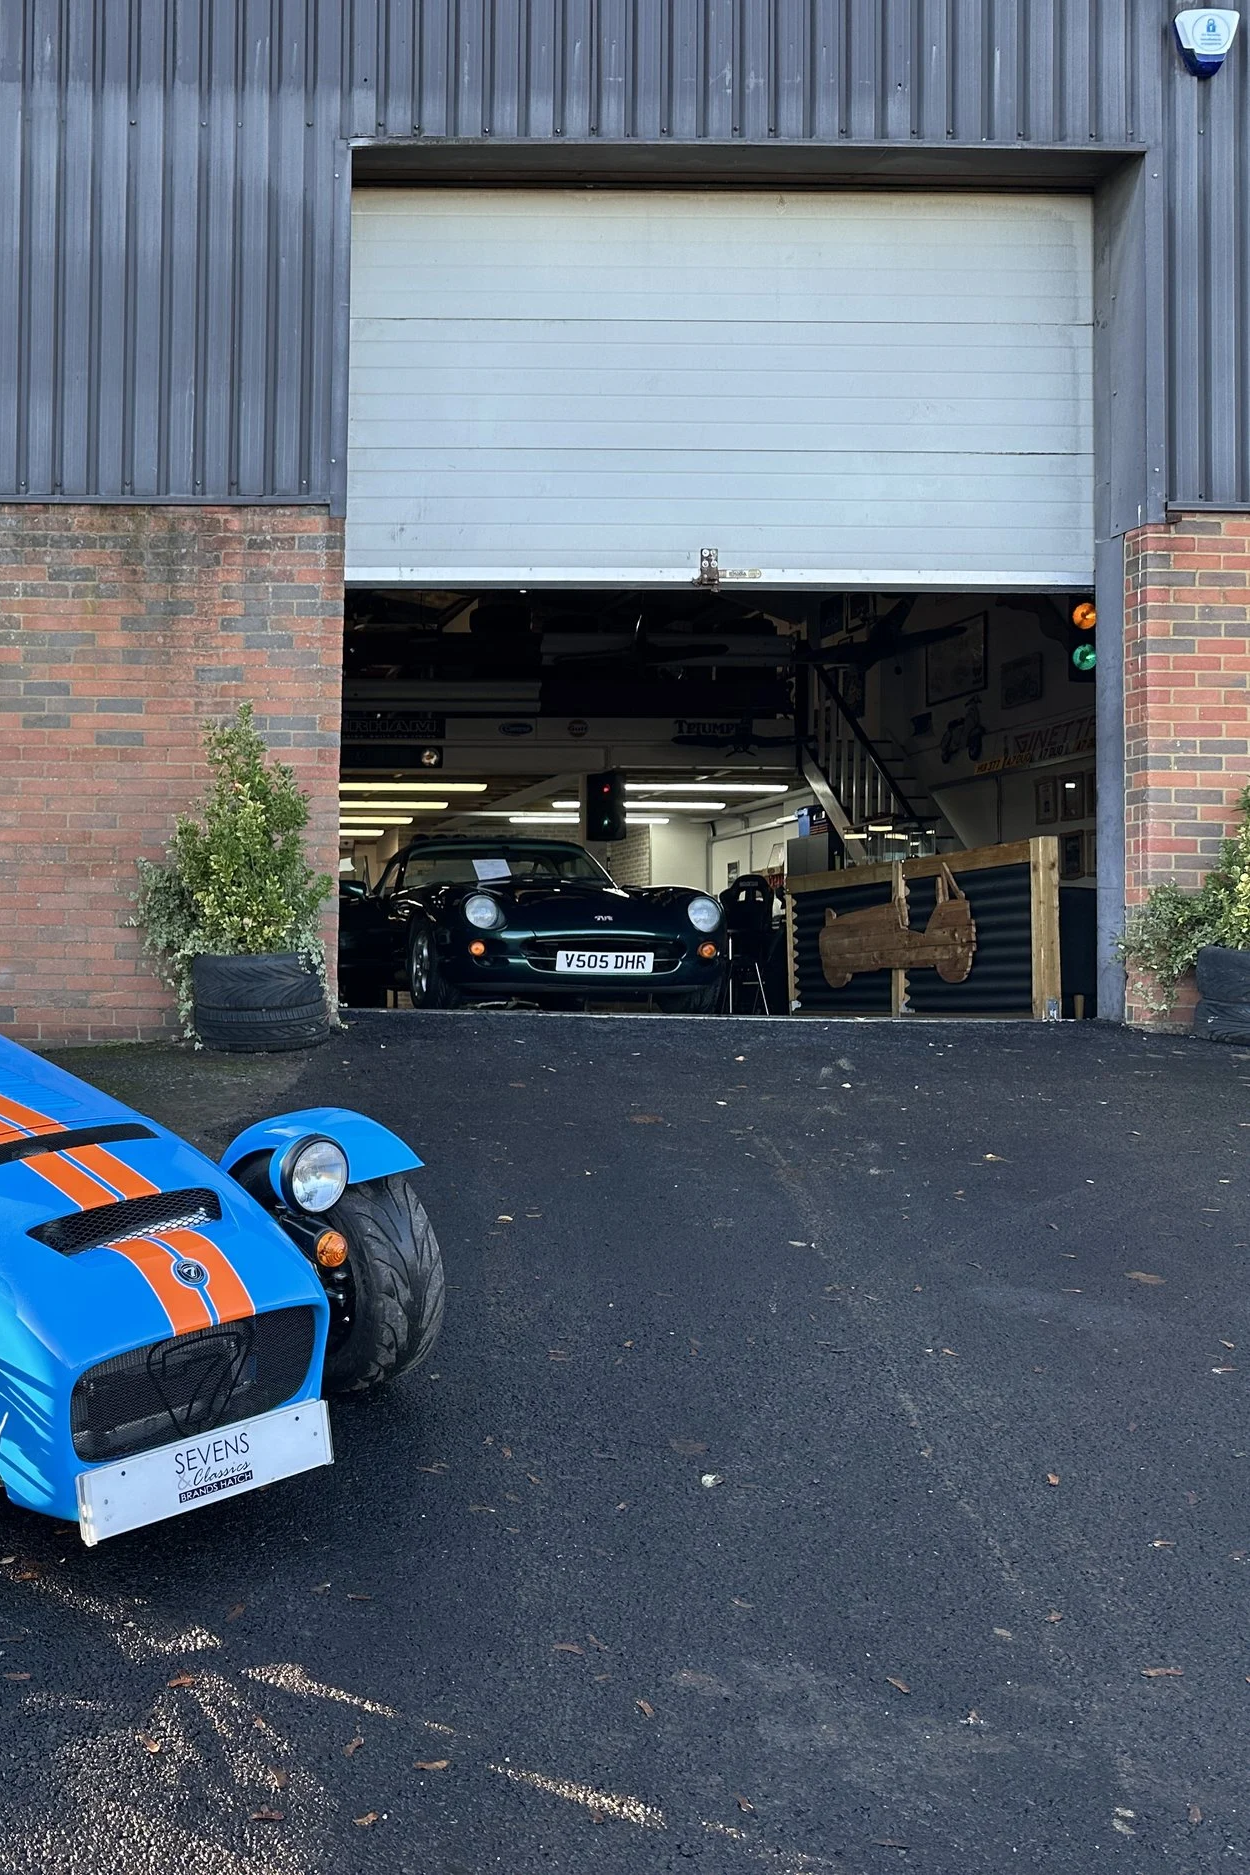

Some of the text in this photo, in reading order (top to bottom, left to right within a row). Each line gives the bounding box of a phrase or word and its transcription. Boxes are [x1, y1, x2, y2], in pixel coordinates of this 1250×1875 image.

[674, 719, 737, 734] TRIUMP
[565, 953, 647, 969] V505 DHR
[175, 1432, 250, 1475] SEVENS
[193, 1461, 251, 1486] Classics
[180, 1472, 252, 1502] BRANDS HATCH
